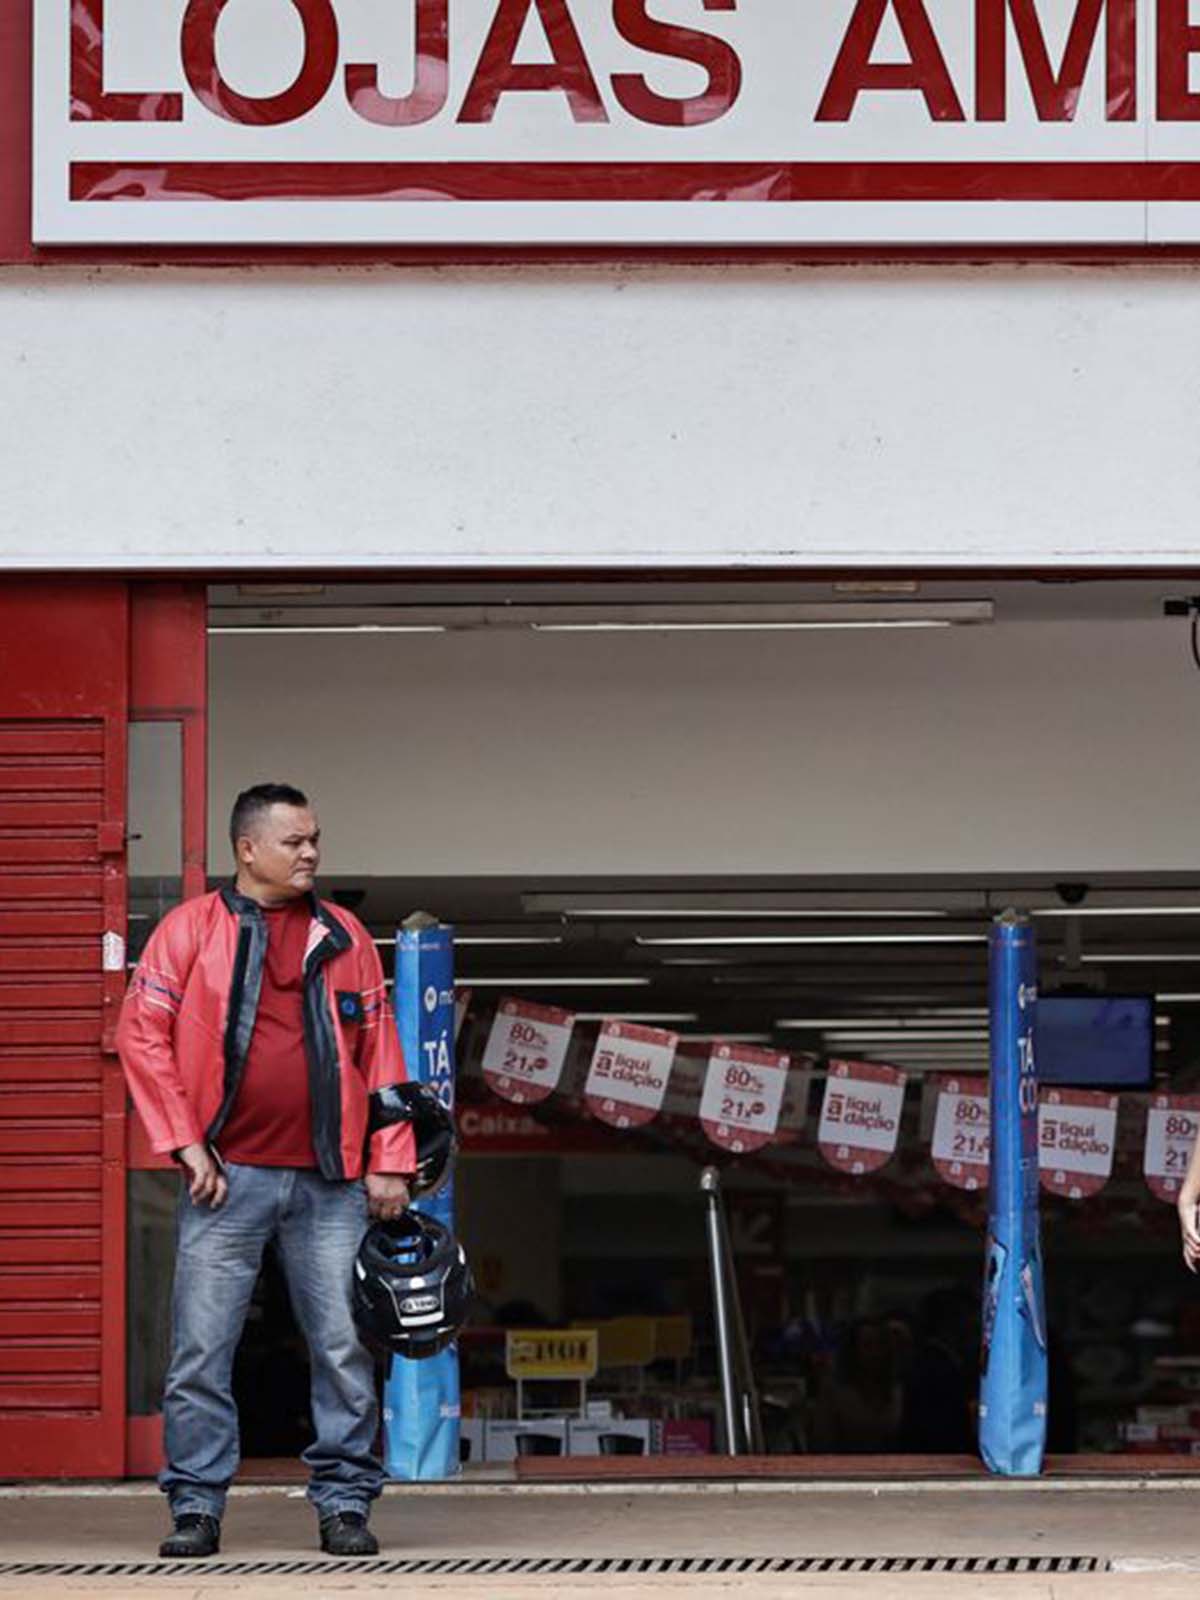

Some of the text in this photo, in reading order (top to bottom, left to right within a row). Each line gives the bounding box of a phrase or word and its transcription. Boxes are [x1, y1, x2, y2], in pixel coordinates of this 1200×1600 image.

[69, 0, 742, 126] LOJAS
[424, 1029, 450, 1077] TÁ
[1165, 1150, 1187, 1167] 21
